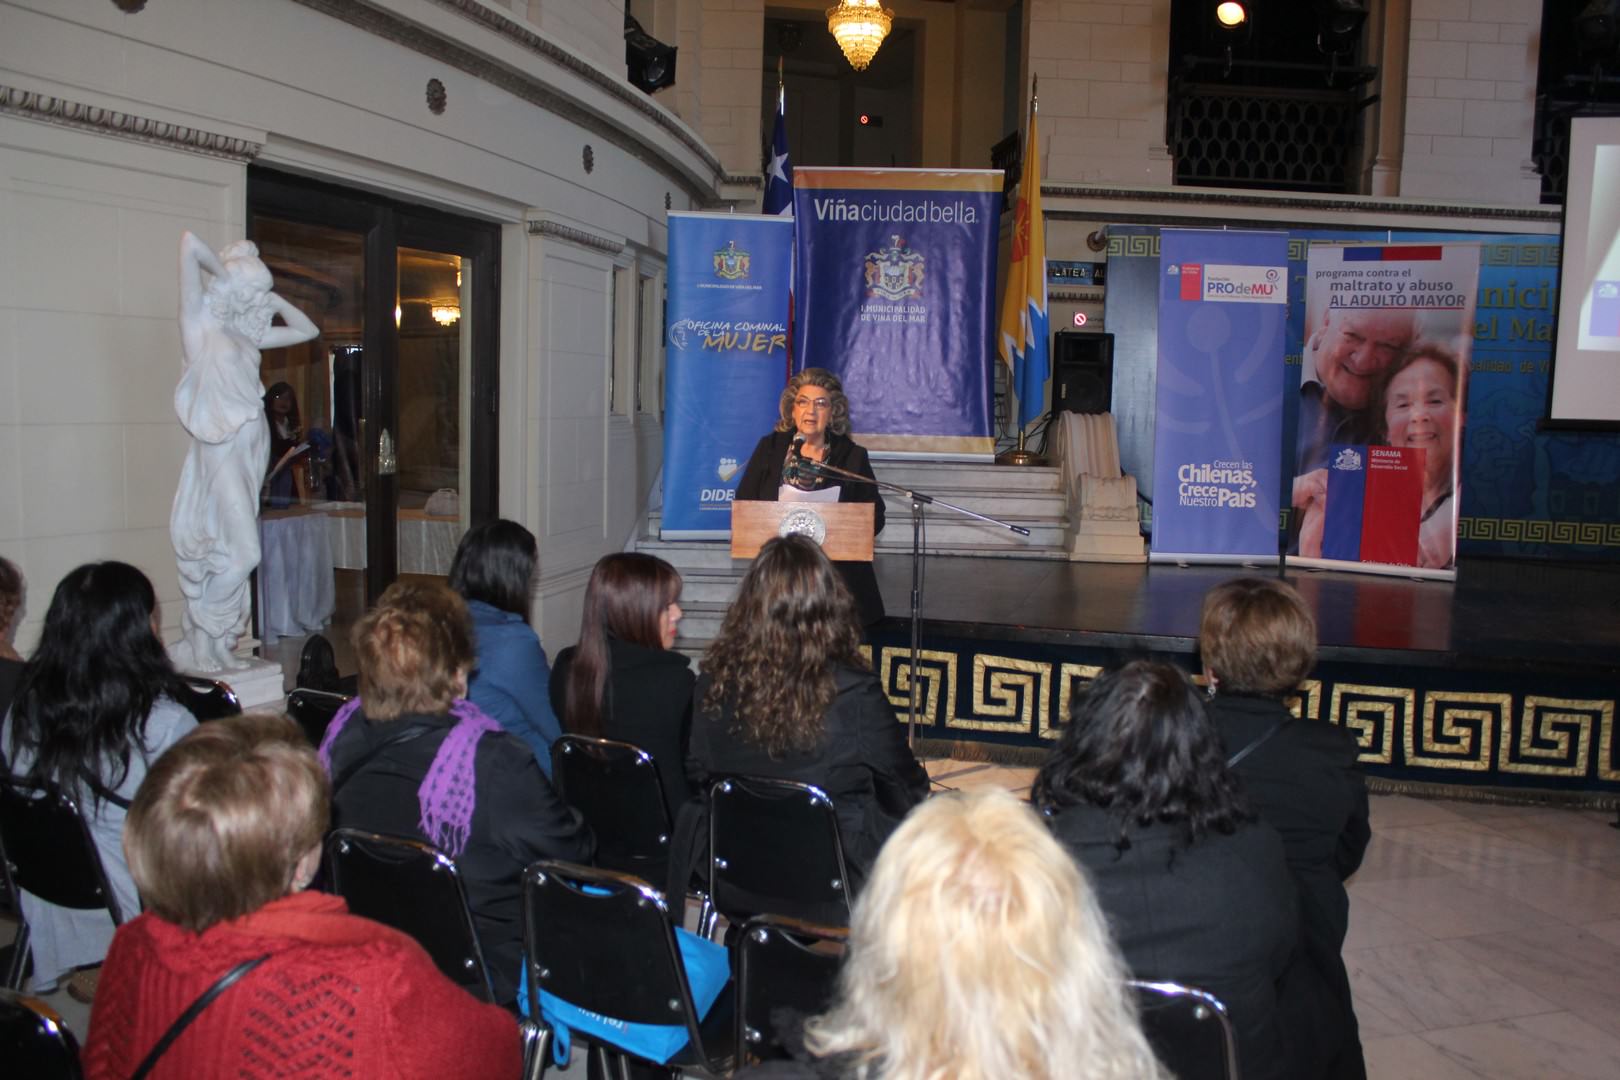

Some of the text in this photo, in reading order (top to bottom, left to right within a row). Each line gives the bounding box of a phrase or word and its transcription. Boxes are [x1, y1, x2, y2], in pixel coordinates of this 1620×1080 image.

[1315, 268, 1412, 279] programa contra el
[1207, 281, 1274, 296] PROdeMU
[1330, 279, 1453, 294] maltrato y abuso
[1330, 294, 1466, 306] AL ADULTO MAYOR
[860, 313, 871, 321] DE
[893, 314, 907, 322] DEL
[909, 314, 927, 323] MAR
[687, 320, 786, 333] OFICINA COMUNAL
[702, 331, 786, 354] MUJER
[1371, 449, 1401, 458] SENAMA
[1213, 460, 1254, 470] Crecen las
[1178, 463, 1257, 488] Chilenas,
[700, 488, 736, 502] DIDE
[1179, 482, 1218, 497] Crece
[1179, 495, 1218, 507] Nuestro
[1218, 485, 1257, 508] País
